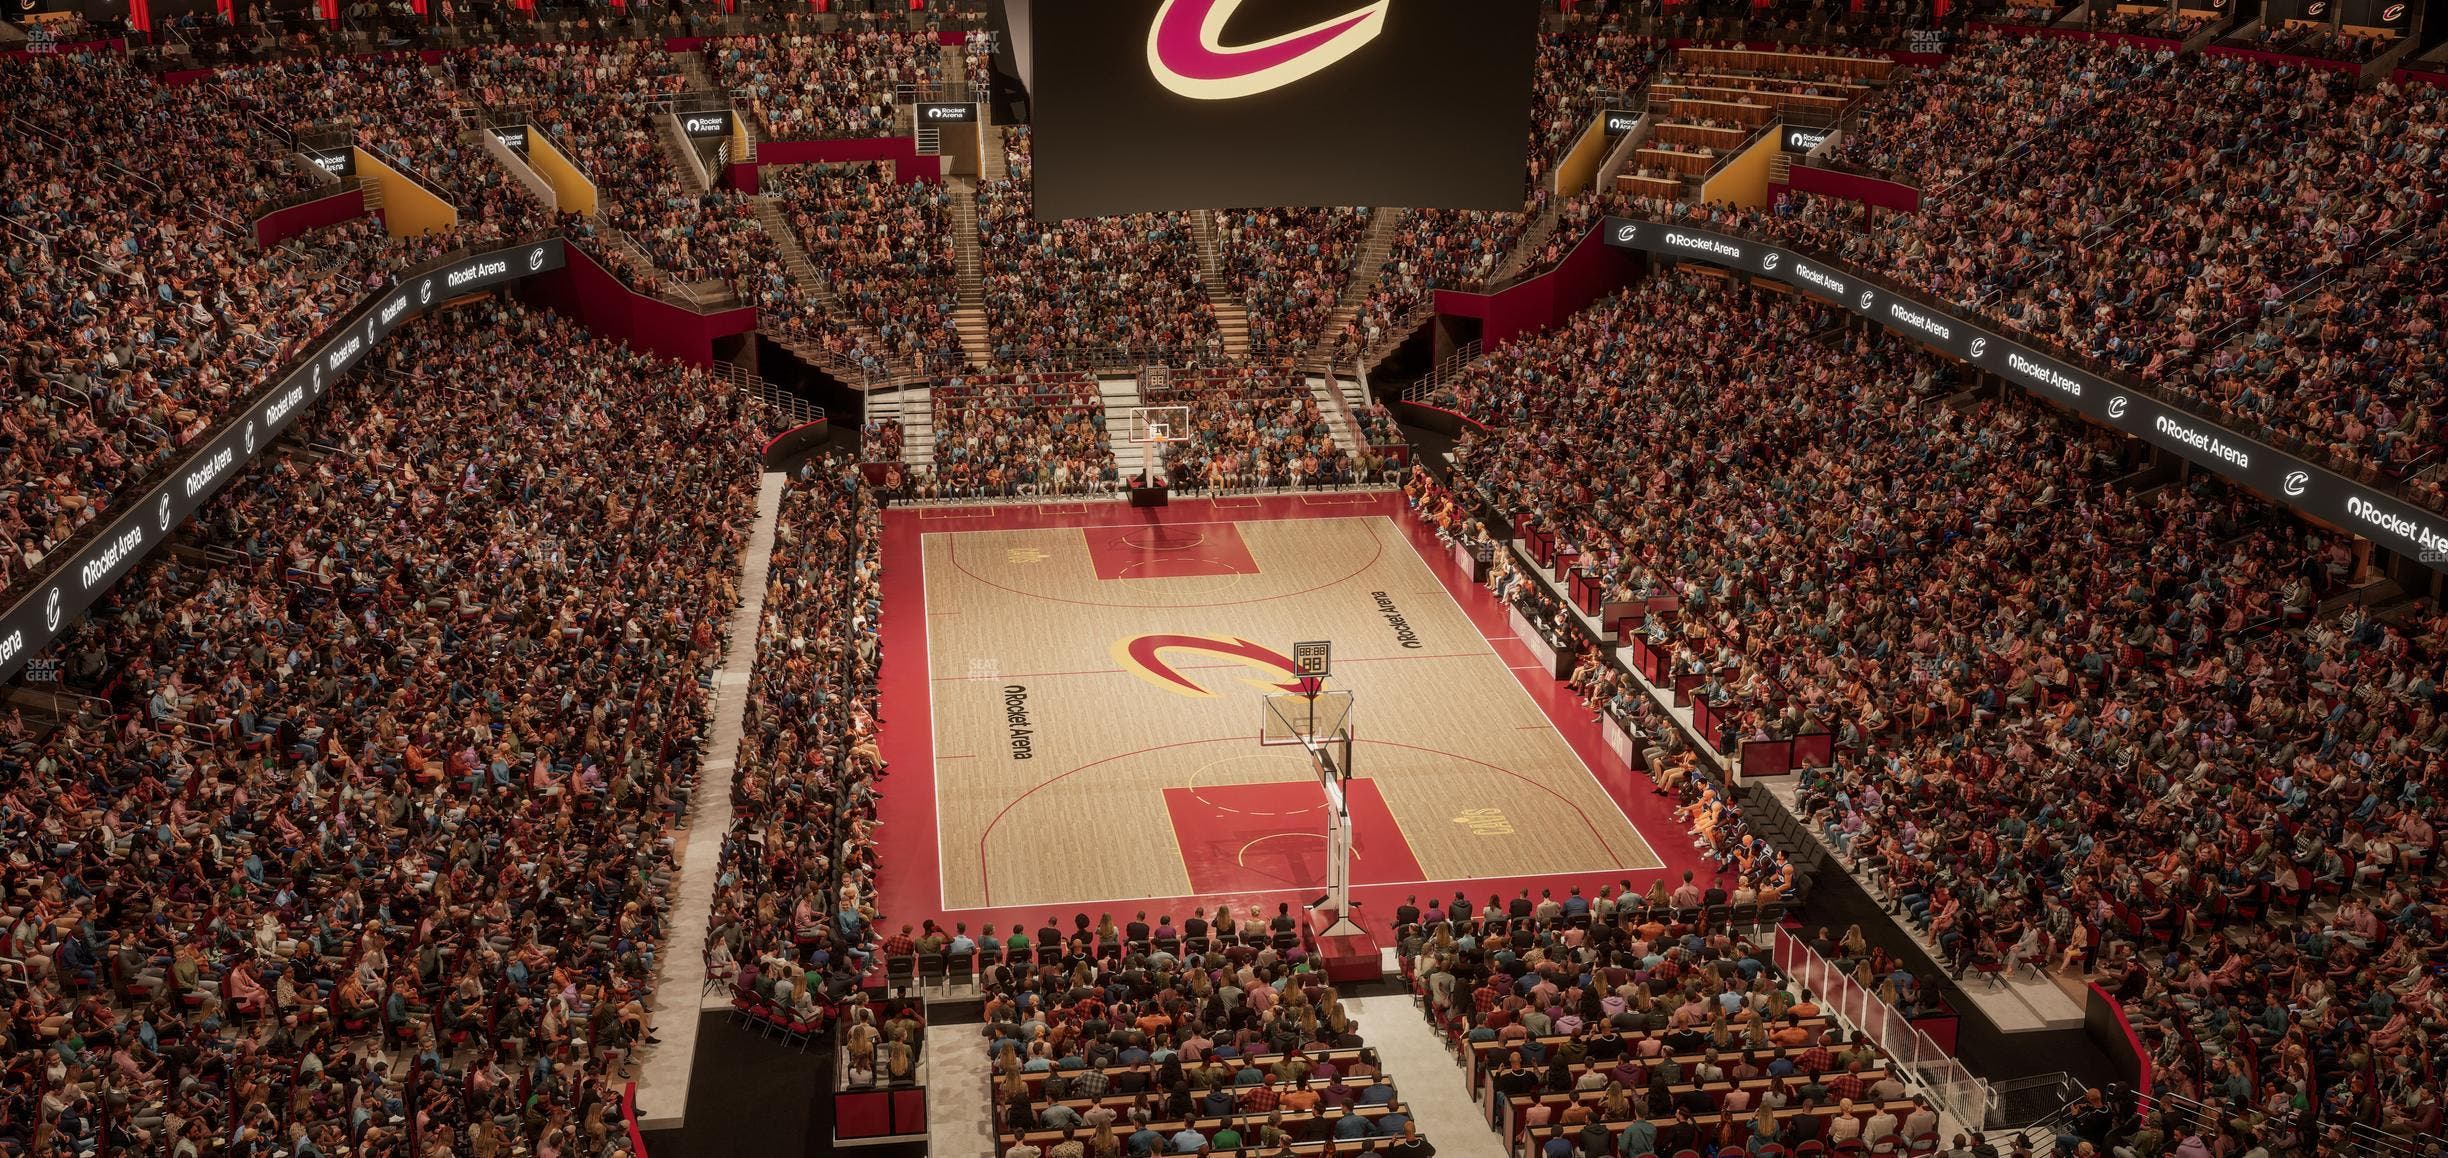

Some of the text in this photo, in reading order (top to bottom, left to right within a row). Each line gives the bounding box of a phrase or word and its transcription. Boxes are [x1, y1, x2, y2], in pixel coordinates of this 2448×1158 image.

[1676, 235, 1740, 258] Rocket Arena
[454, 260, 506, 287] Rocket Arena
[1802, 265, 1844, 294] Rocket Arena
[1898, 306, 1950, 340] Rocket Arena
[2017, 355, 2081, 397] Rocket Arena
[270, 386, 303, 423] Rocket Arena
[2167, 419, 2249, 469] Rocket Arena
[191, 447, 233, 493] Rocket Arena
[2362, 501, 2418, 541] Rocket
[90, 526, 142, 584] Rocket Arena
[1371, 591, 1418, 642] Rocket Arena
[0, 629, 23, 666] rena
[1004, 694, 1033, 760] Rocket Arena
